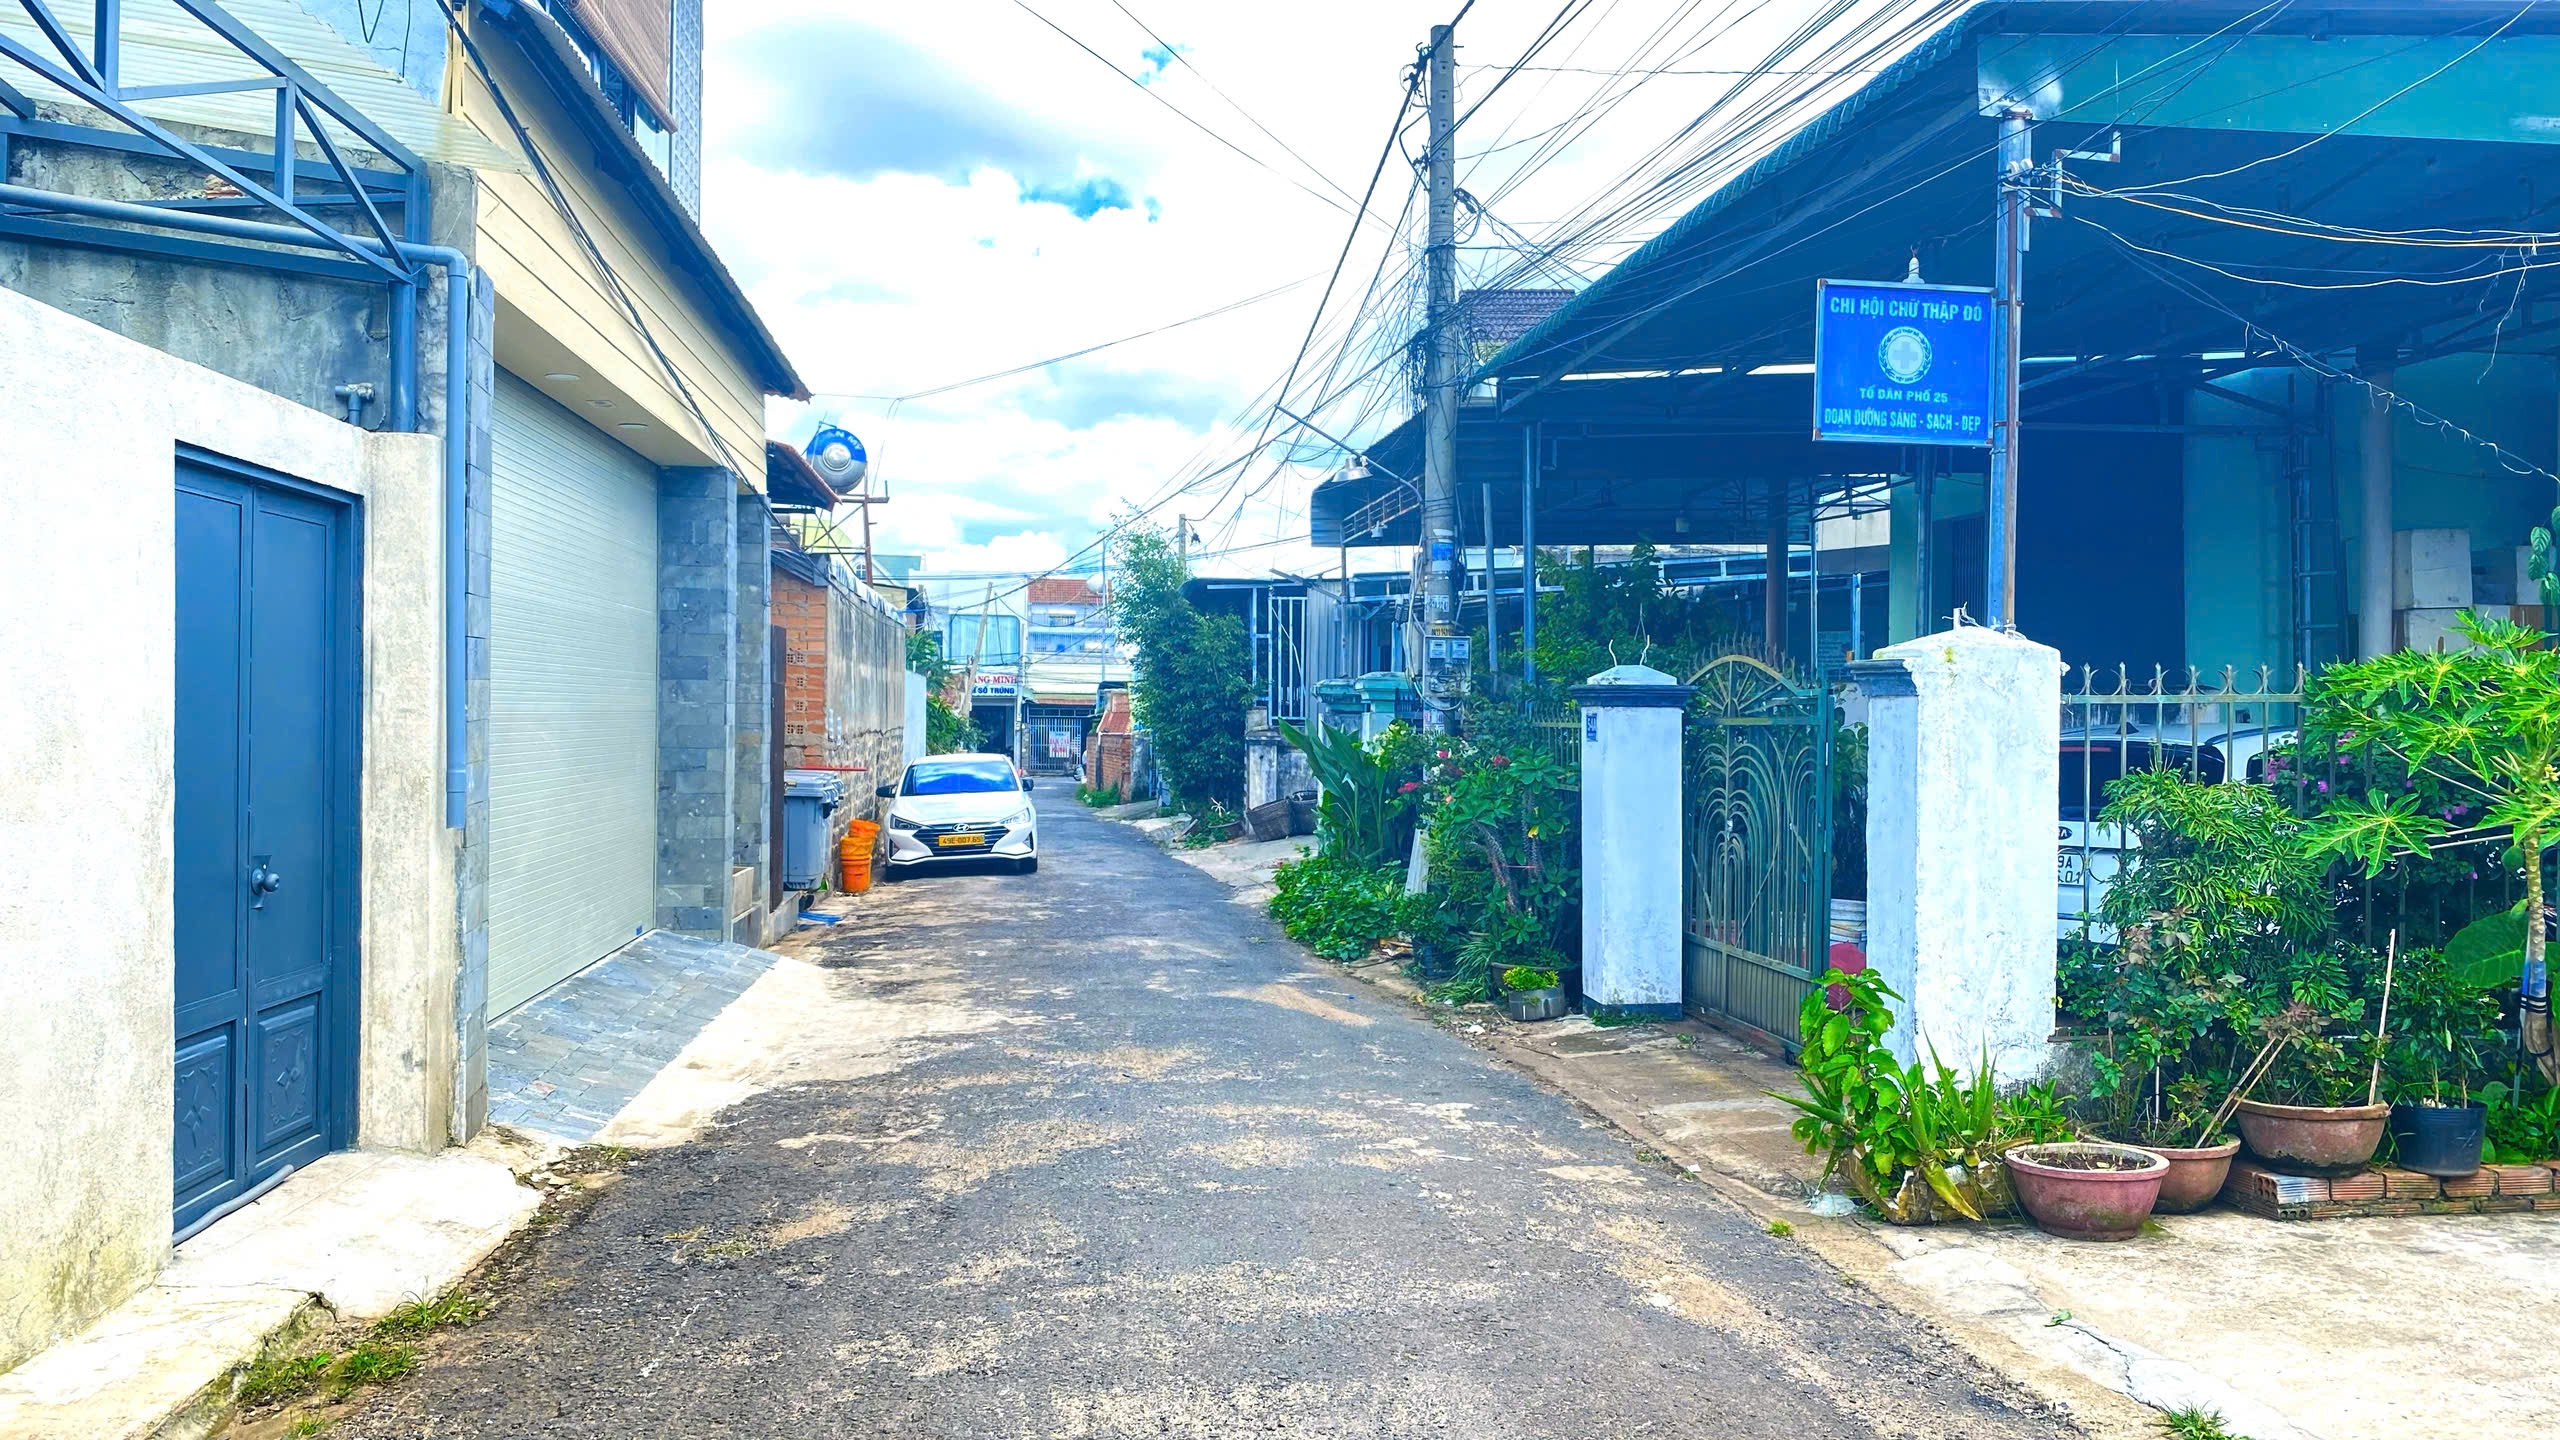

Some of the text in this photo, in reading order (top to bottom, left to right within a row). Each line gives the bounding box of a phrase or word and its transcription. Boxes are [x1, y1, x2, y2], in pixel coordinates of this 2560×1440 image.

[1830, 295, 1983, 323] CHI HỘI CHỮ THẬP ĐỎ
[1877, 387, 1902, 400] DÂN
[1933, 392, 1948, 403] 25
[1824, 408, 1851, 428] ĐOẠN
[1889, 408, 1917, 428] SÁNG
[1926, 412, 1952, 433] SẠCH
[1961, 415, 1981, 435] ĐẸP
